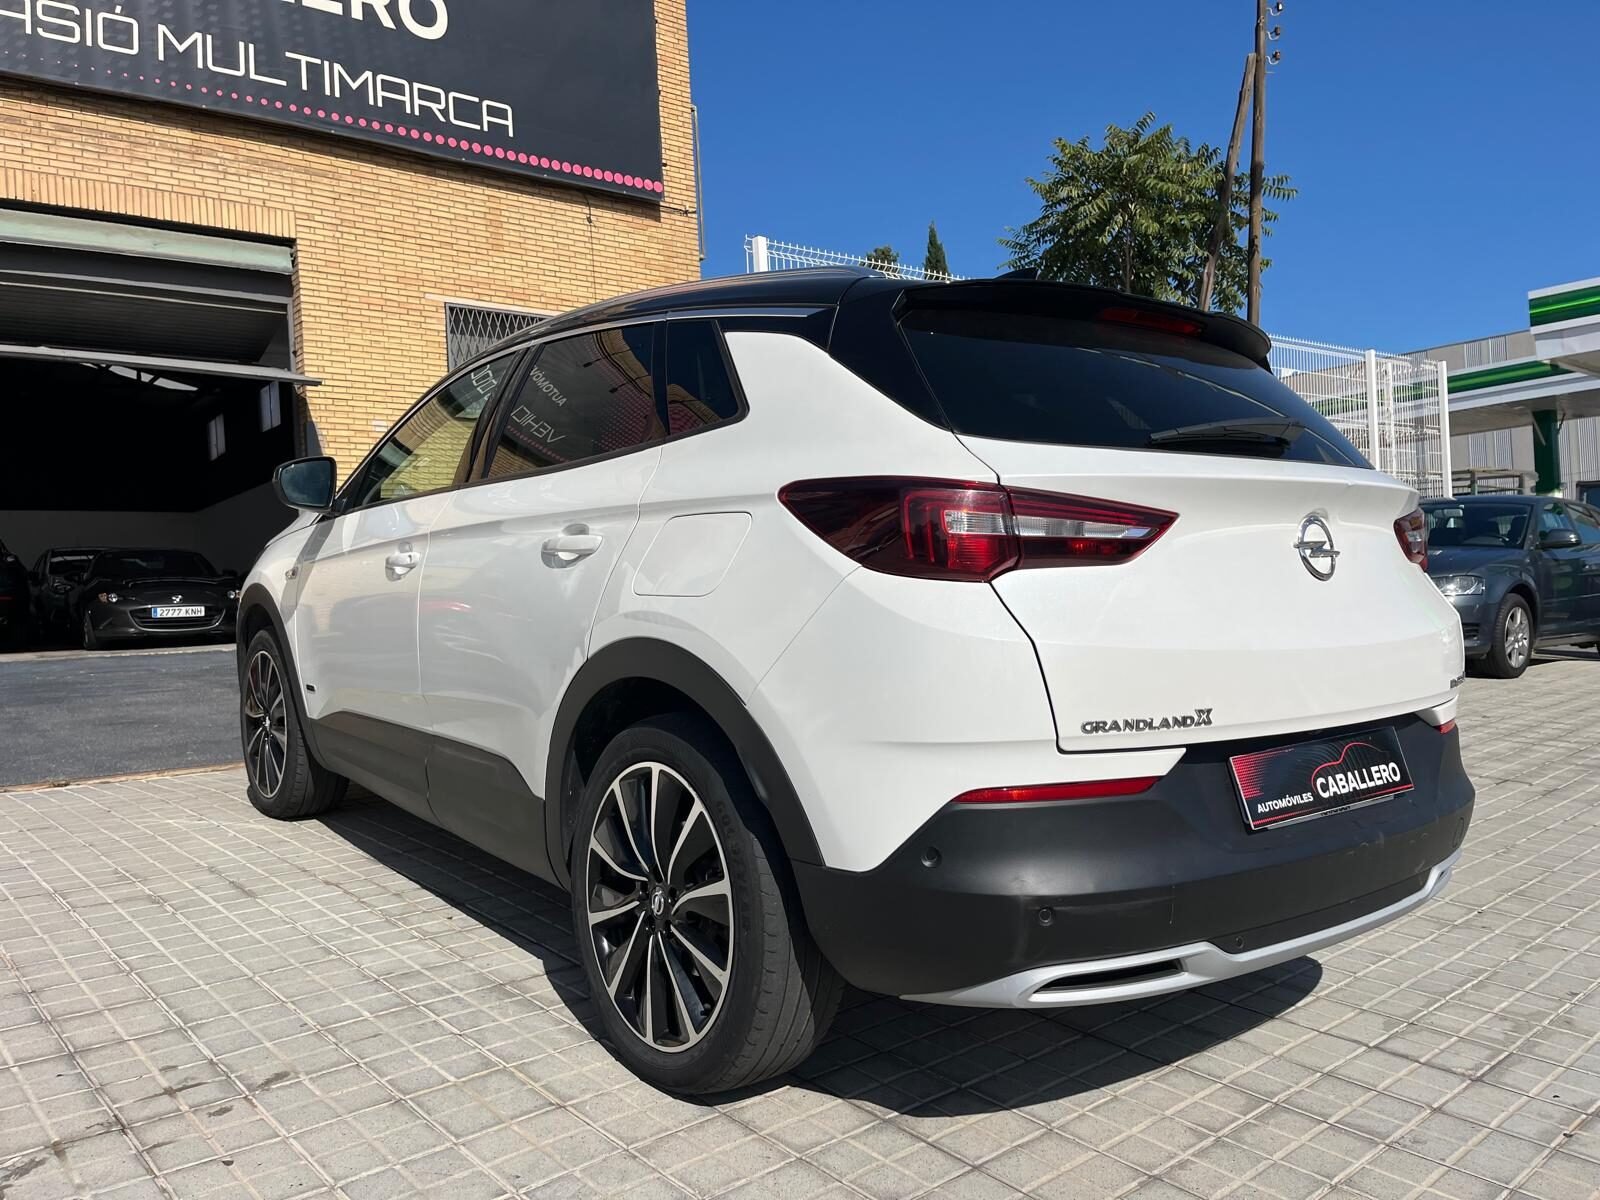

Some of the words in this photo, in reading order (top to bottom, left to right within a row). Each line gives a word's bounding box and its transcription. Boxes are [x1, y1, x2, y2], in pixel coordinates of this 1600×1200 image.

[157, 24, 514, 137] MULTIMARCA
[159, 608, 182, 616] 2777
[185, 607, 202, 616] KNH
[1257, 792, 1314, 814] AUTOMÓVILES
[1316, 761, 1401, 799] CABALLERO
